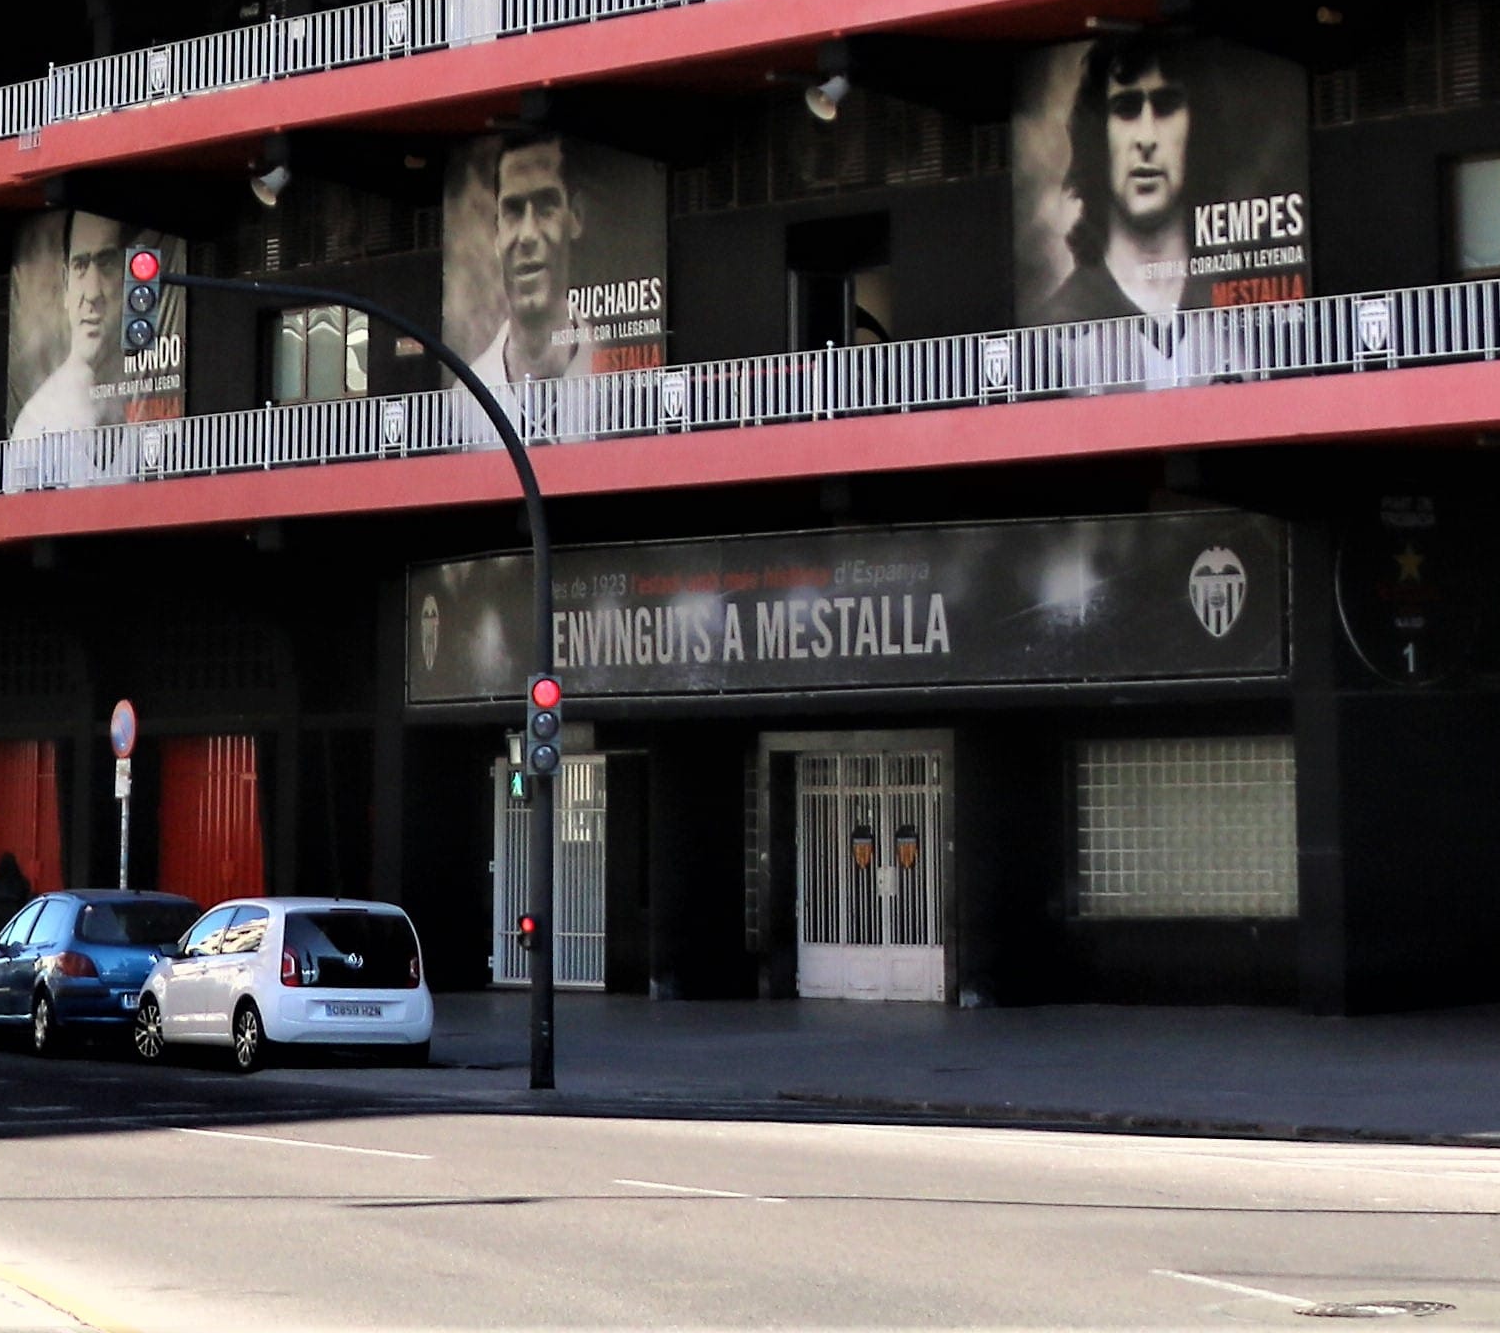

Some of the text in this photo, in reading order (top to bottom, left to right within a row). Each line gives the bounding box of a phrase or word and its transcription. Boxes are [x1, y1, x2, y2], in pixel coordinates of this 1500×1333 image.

[1194, 193, 1304, 248] KEMPES
[1190, 249, 1241, 276] CORAZÓN
[1242, 253, 1251, 270] Y
[1253, 244, 1305, 268] LEYENDA
[591, 573, 627, 598] 1923
[552, 593, 951, 668] ENVINGUTS A MESTALLA
